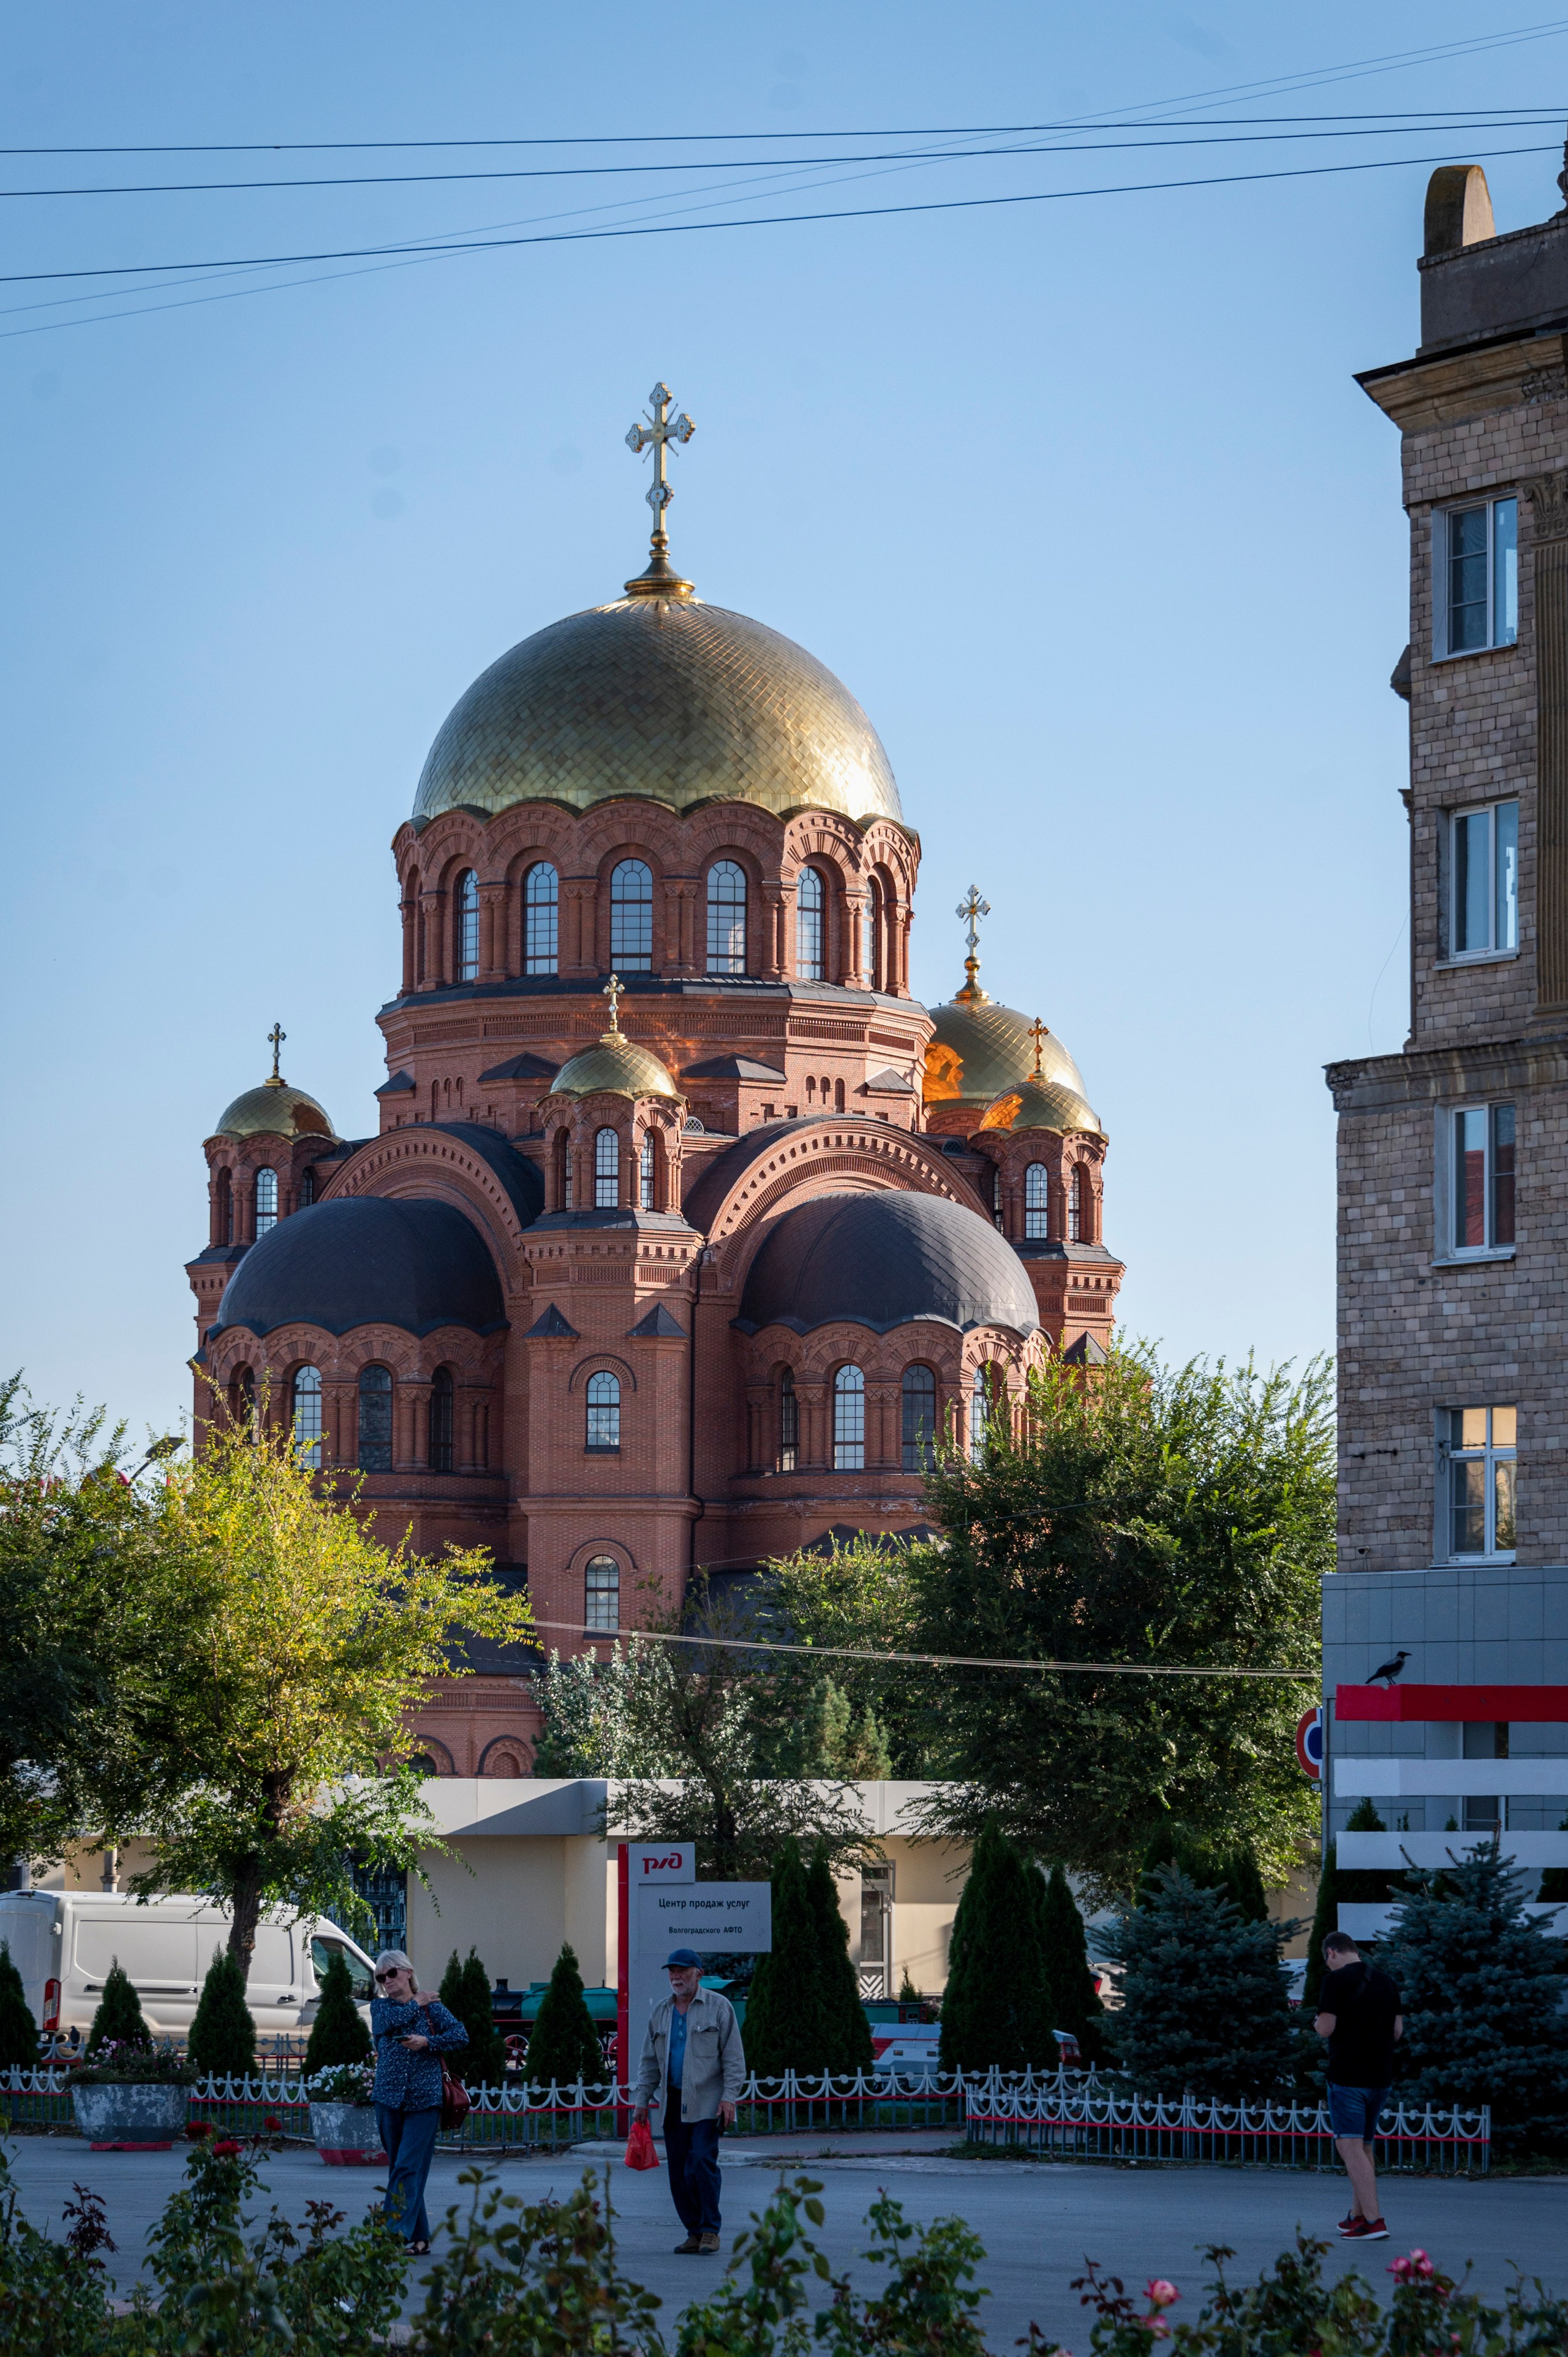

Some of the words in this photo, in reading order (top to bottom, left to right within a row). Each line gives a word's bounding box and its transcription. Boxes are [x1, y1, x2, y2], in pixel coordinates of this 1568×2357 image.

[658, 1898, 687, 1909] Центр
[689, 1900, 724, 1909] продаж
[726, 1900, 750, 1909] услуг
